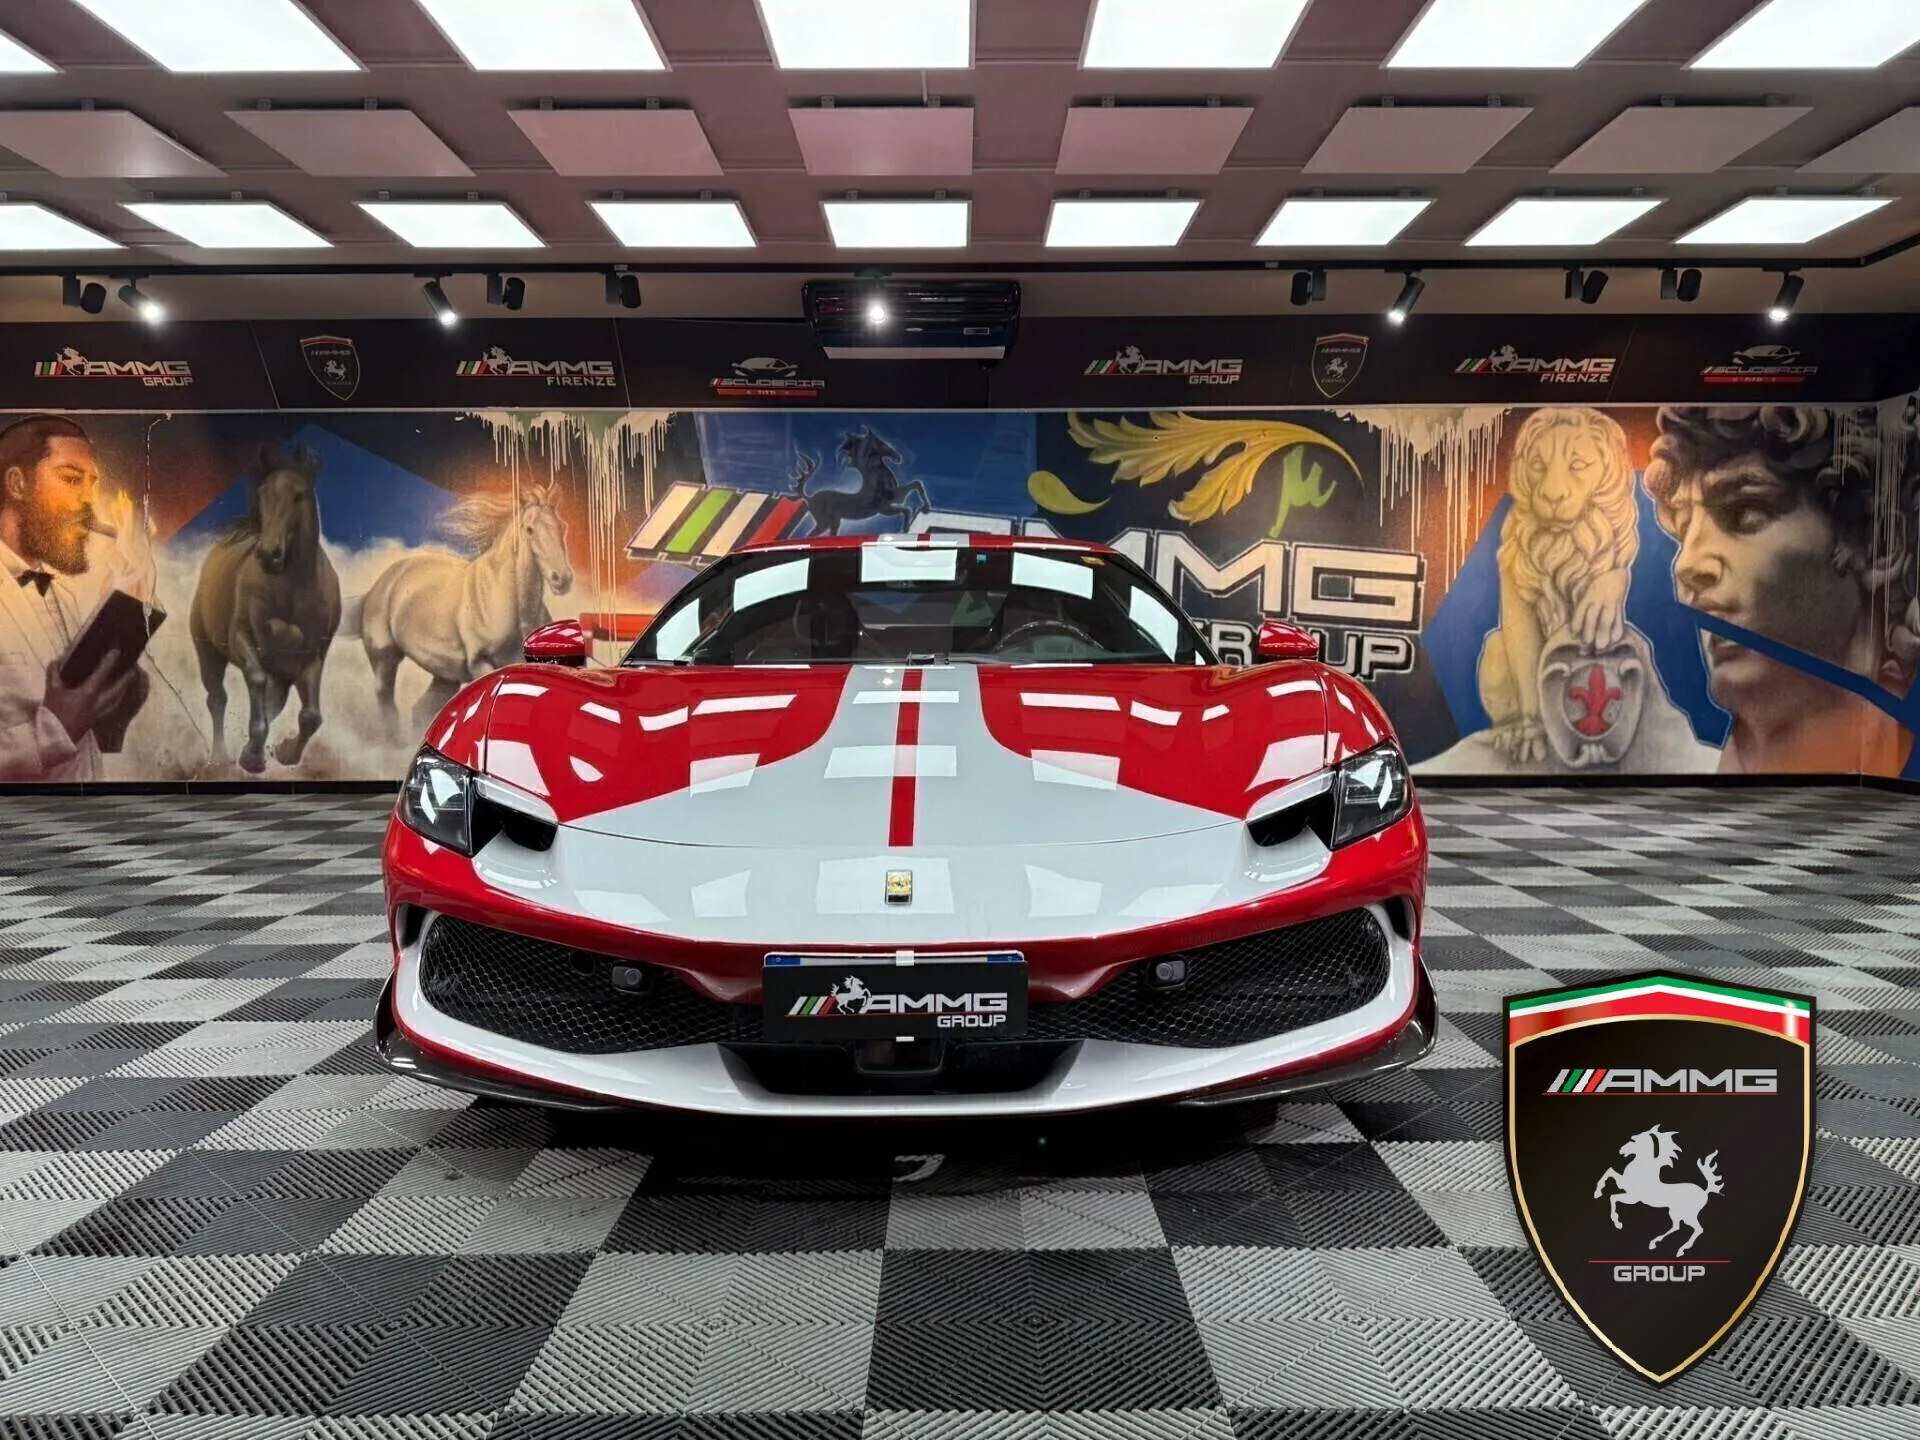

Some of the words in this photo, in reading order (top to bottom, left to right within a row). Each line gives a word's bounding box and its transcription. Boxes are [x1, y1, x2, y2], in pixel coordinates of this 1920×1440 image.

[84, 360, 192, 375] AMMG
[508, 360, 614, 375] AMMG
[1134, 359, 1243, 374] AMMG
[1506, 358, 1616, 372] AMMG
[143, 376, 193, 387] GROUP
[547, 376, 617, 386] FIRENZE
[1189, 375, 1240, 385] GROUP
[1540, 373, 1611, 383] FIRENZE
[859, 992, 1008, 1014] AMMG
[936, 1014, 1007, 1028] GROUP
